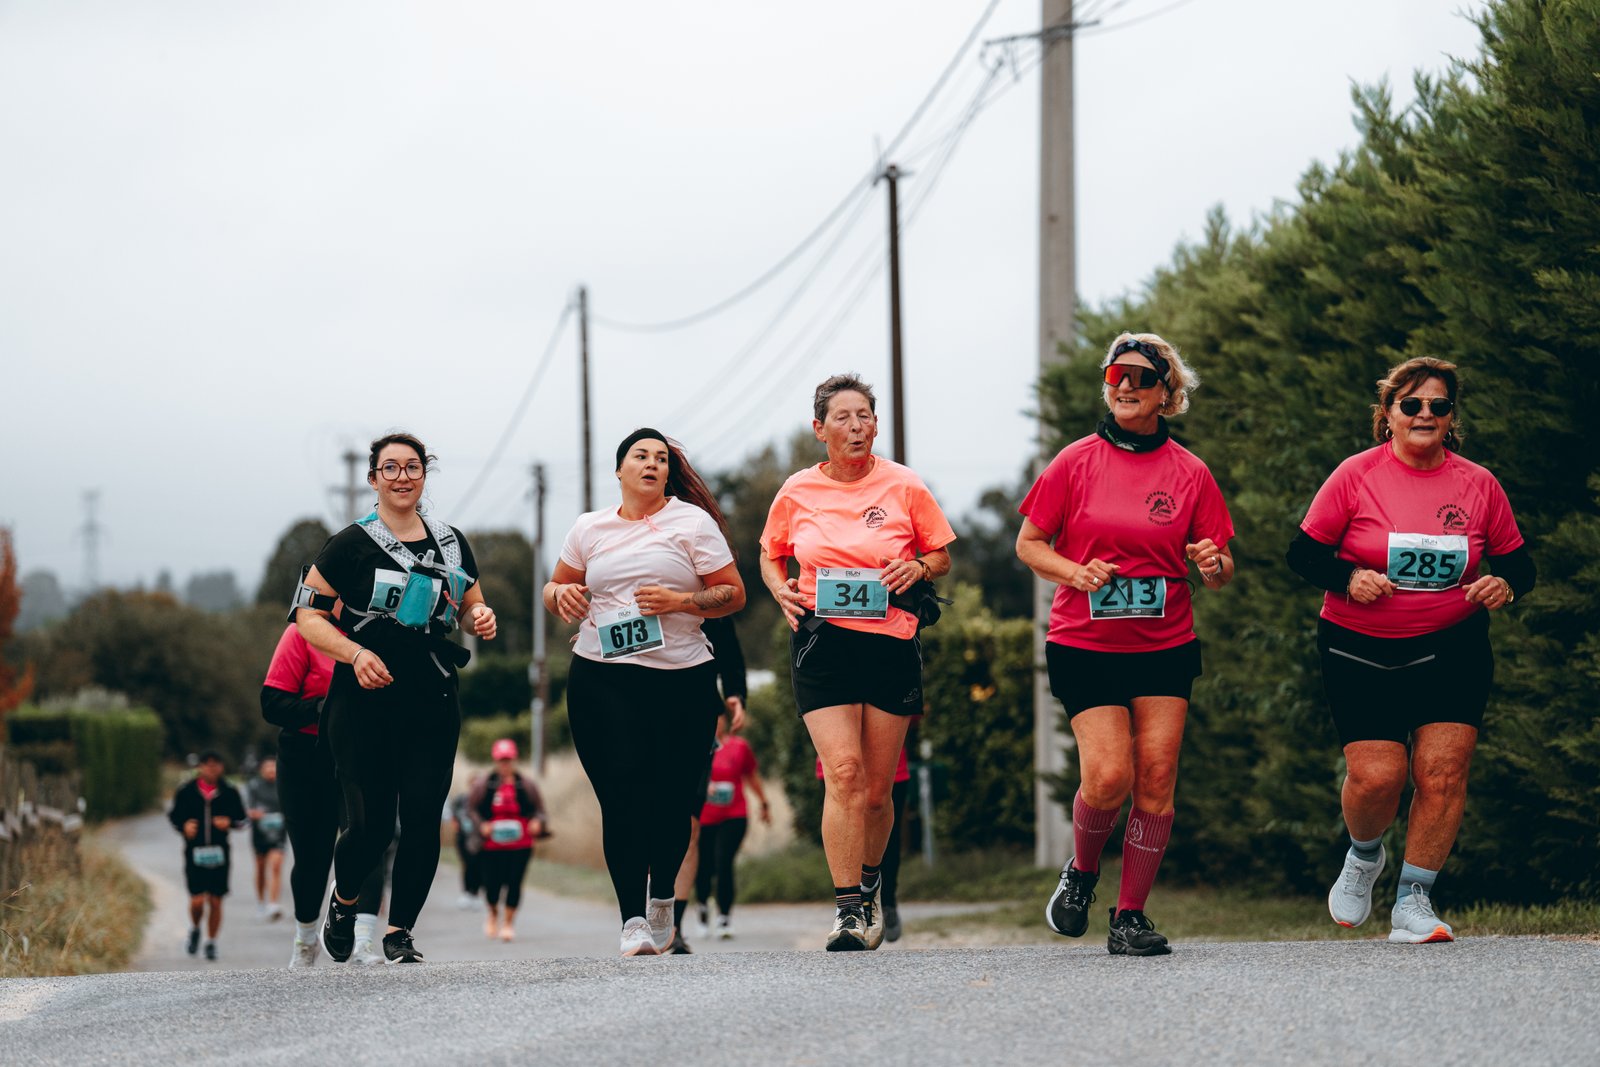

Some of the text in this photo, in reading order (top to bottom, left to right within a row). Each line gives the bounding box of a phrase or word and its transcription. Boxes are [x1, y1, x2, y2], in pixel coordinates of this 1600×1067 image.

[1397, 551, 1456, 578] 285
[834, 583, 870, 607] 34
[1100, 577, 1157, 606] 213
[610, 619, 649, 649] 673
